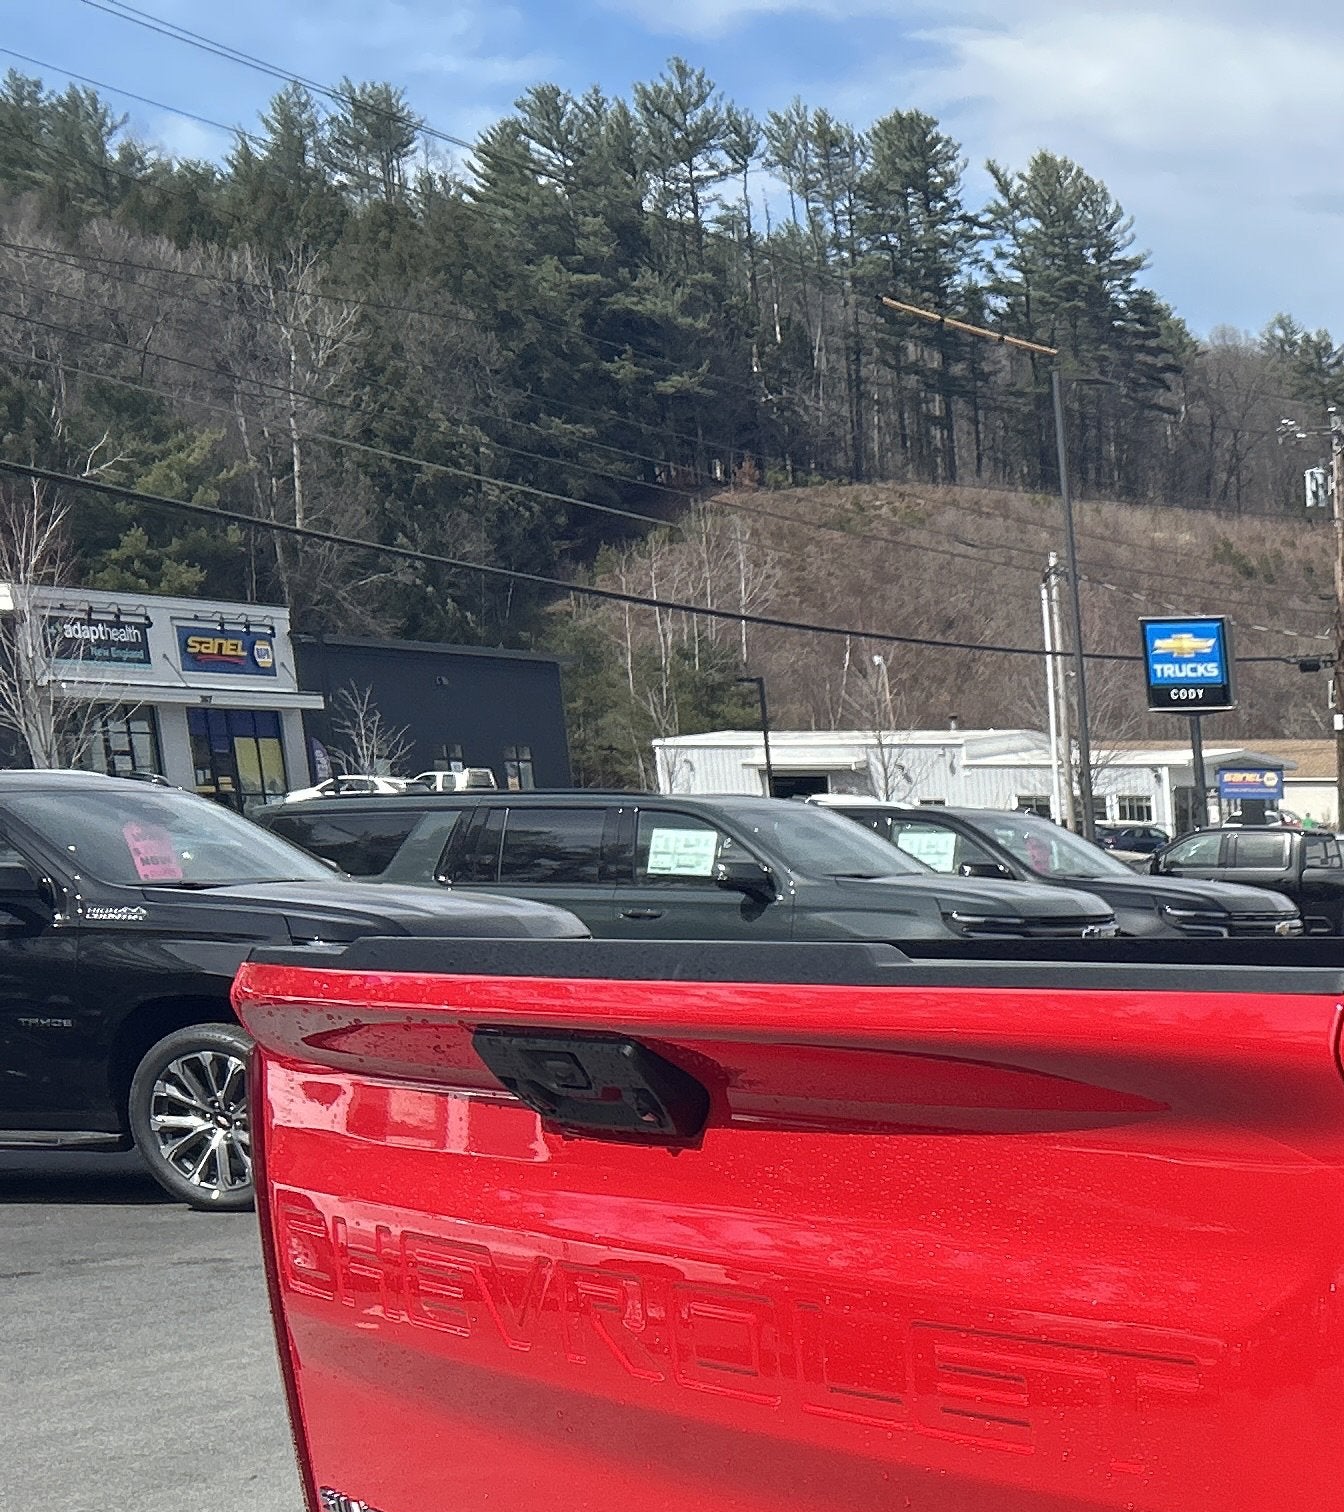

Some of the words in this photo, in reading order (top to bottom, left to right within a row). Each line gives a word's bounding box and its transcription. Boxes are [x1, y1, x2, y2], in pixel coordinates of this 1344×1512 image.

[63, 622, 142, 643] adapthealth
[1153, 663, 1219, 678] TRUCKS
[1170, 688, 1204, 700] CODY
[275, 1186, 1223, 1475] CHEVROLET
